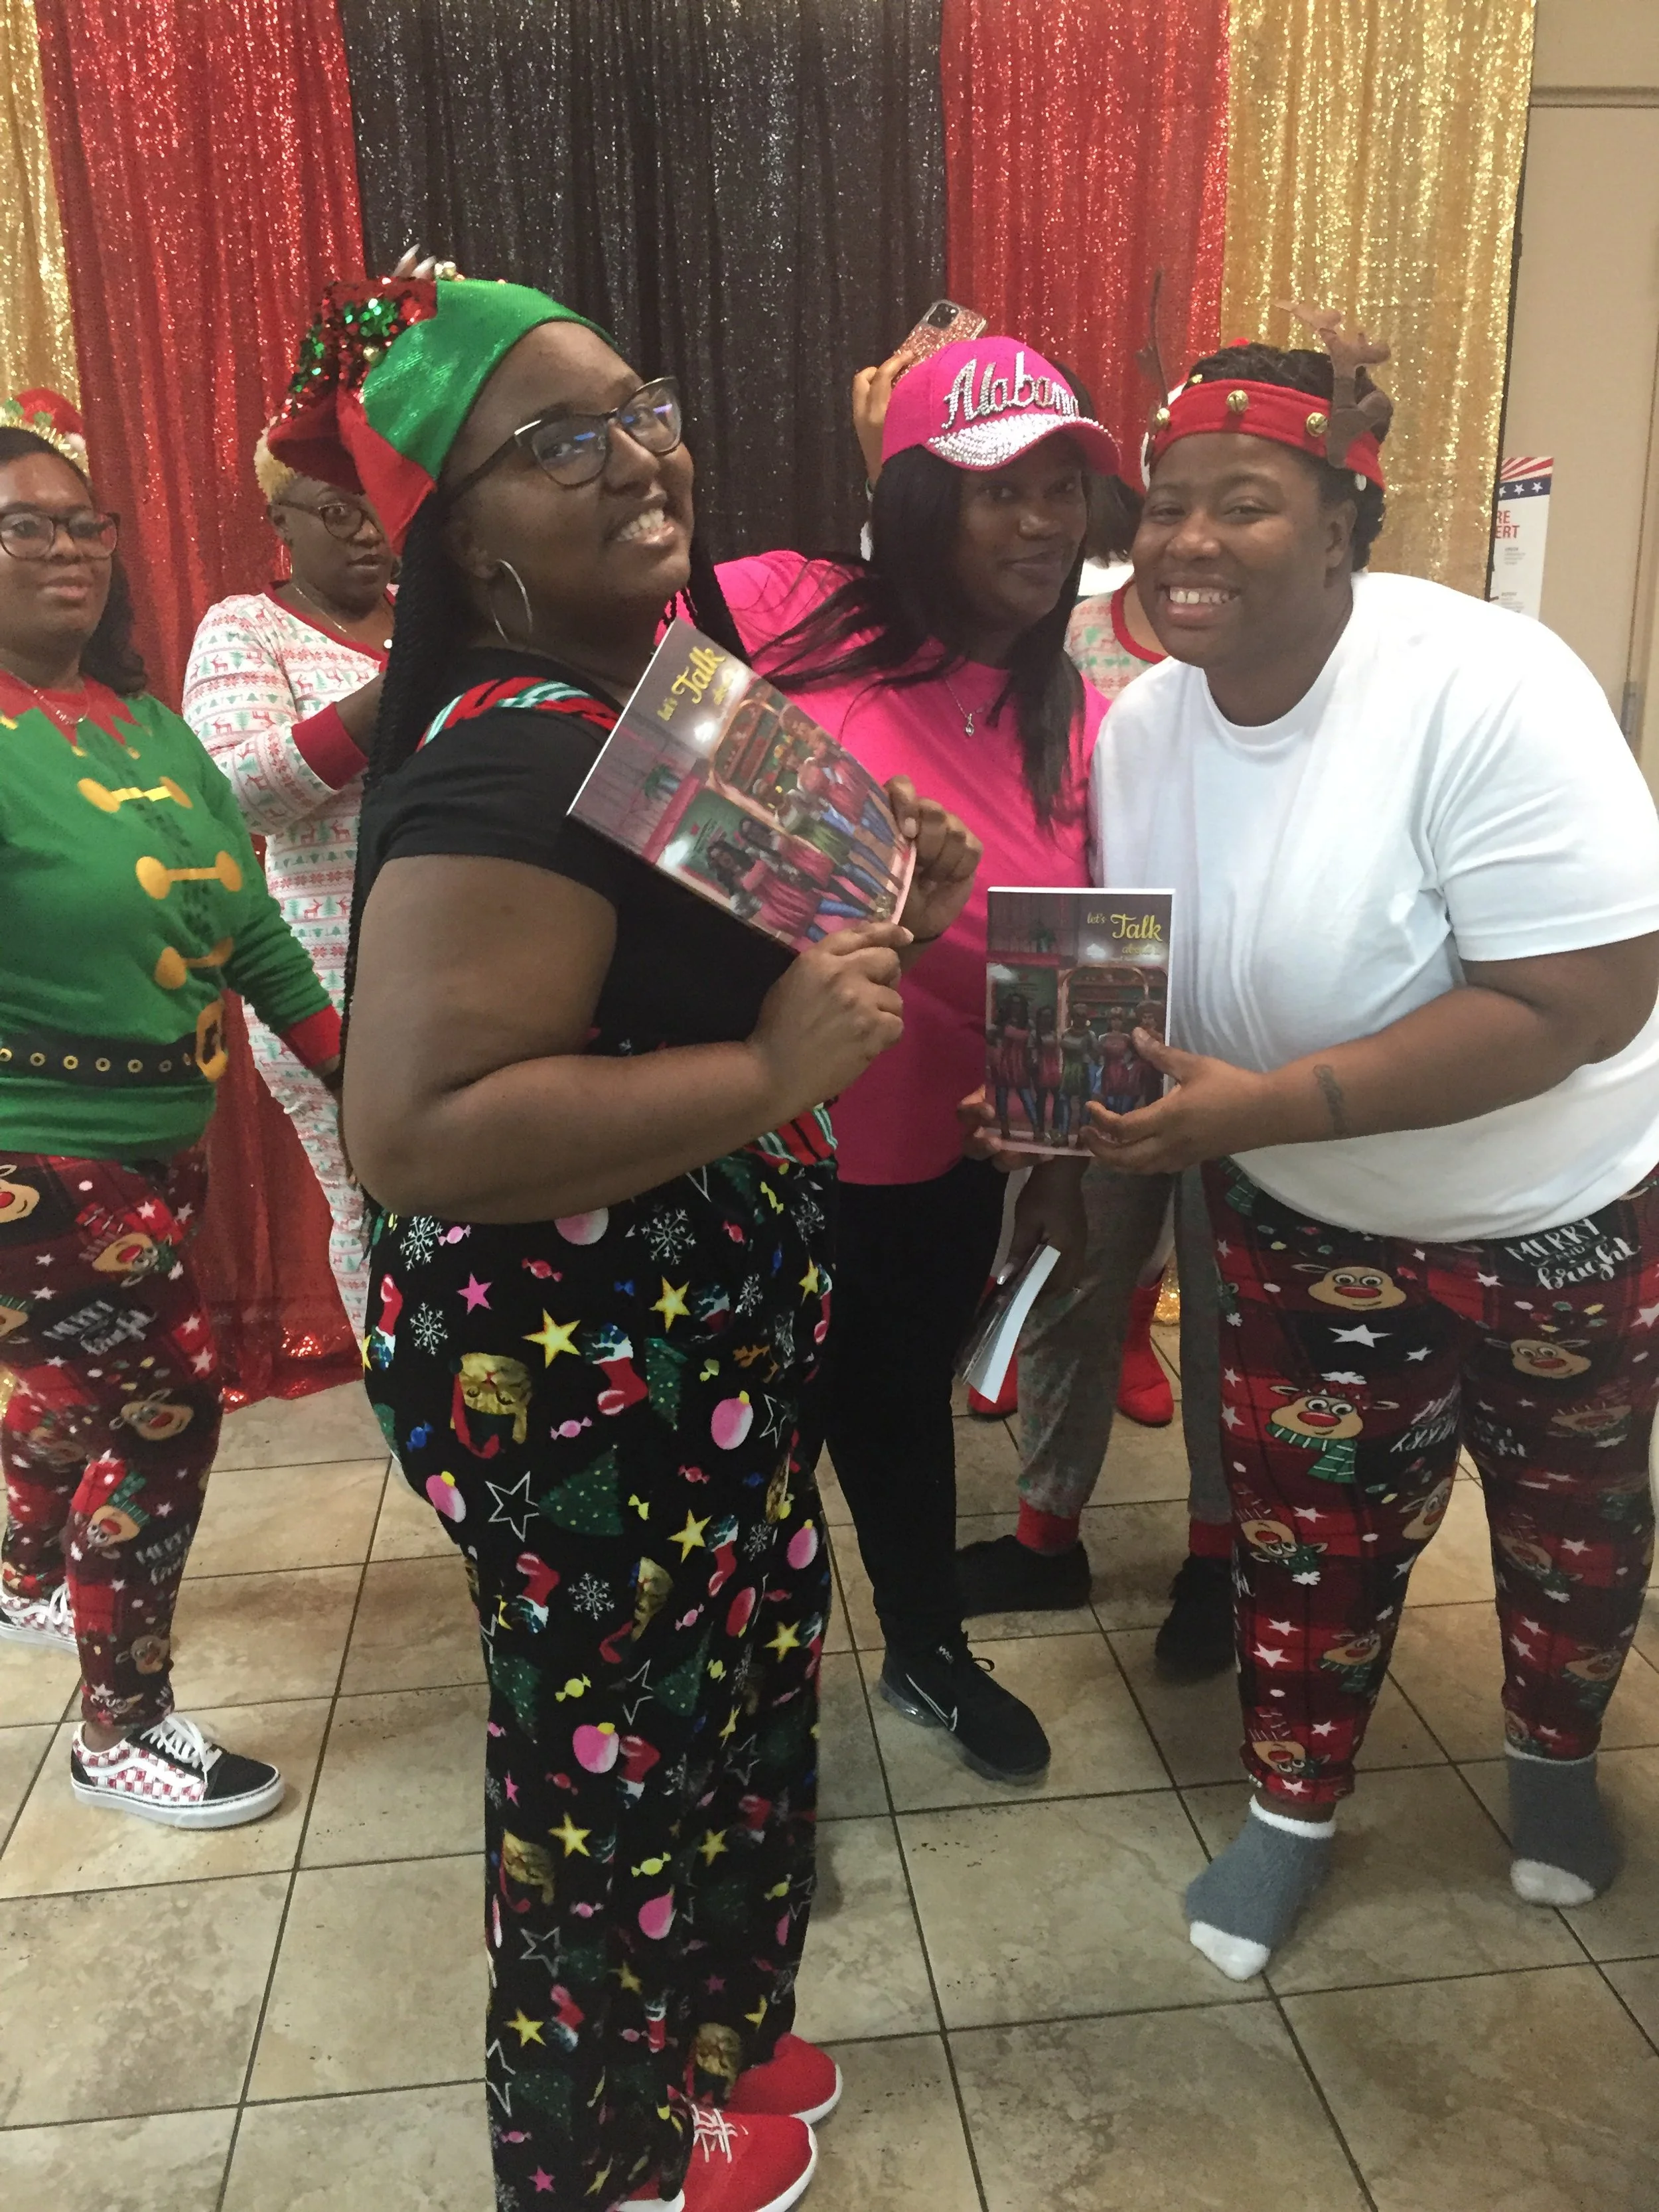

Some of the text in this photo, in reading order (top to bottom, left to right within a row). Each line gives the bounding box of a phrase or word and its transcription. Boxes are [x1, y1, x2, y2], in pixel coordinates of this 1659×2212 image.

[672, 646, 726, 704] Talk
[1110, 913, 1163, 942] Talk
[1504, 1218, 1600, 1261] MERRY
